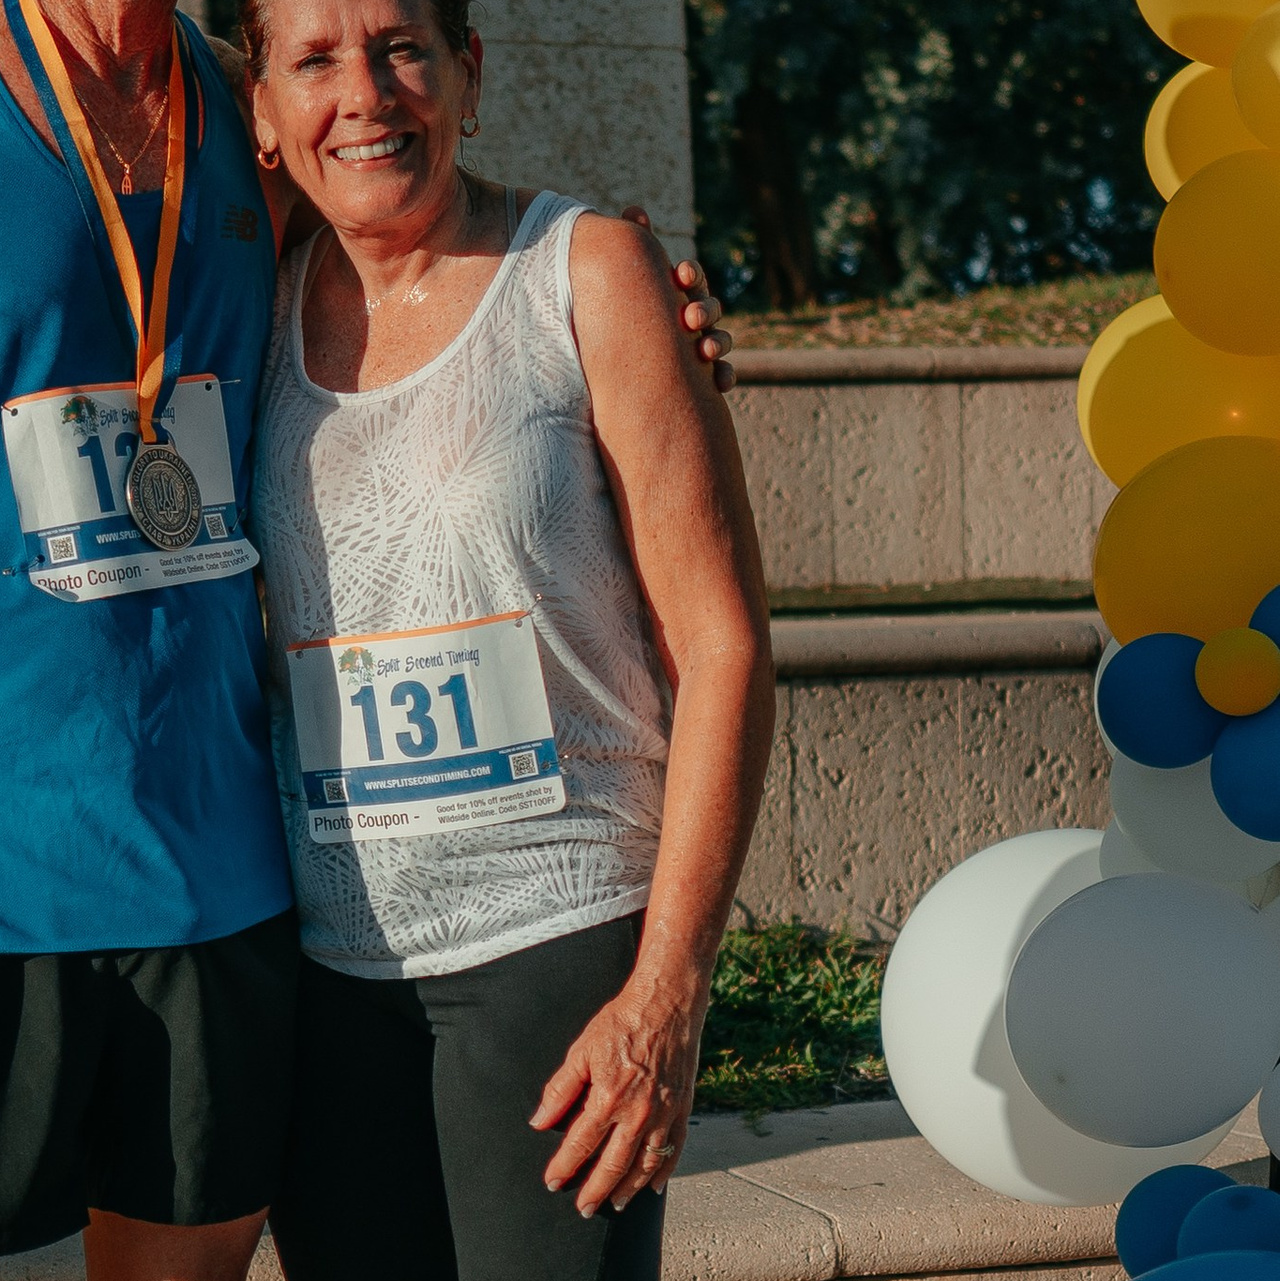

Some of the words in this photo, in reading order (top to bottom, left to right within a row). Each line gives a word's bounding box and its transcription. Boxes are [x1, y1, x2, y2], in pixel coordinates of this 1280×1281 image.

[100, 409, 119, 428] Split
[159, 557, 173, 566] Good
[174, 556, 182, 564] for
[183, 554, 196, 563] 10%
[205, 551, 221, 560] events
[222, 548, 235, 557] shot
[236, 547, 244, 555] by
[38, 575, 83, 592] Photo
[87, 565, 142, 585] Coupon
[162, 567, 187, 577] Wildside
[206, 562, 220, 571] Code
[376, 657, 400, 678] Split
[405, 651, 444, 673] Second
[445, 648, 480, 667] Timing
[350, 673, 478, 762] 131
[364, 765, 491, 791] WWW.SPLITSECONDTIMING.COM
[436, 803, 455, 814] Good
[457, 802, 467, 810] for
[469, 799, 486, 809] 10%
[488, 796, 498, 805] off
[500, 792, 524, 803] events
[526, 787, 542, 797] shot
[543, 786, 553, 795] by
[314, 813, 353, 832] Photo
[357, 812, 409, 830] Coupon
[438, 812, 470, 824] Wildside
[471, 808, 497, 819] Online.
[498, 804, 518, 815] Code
